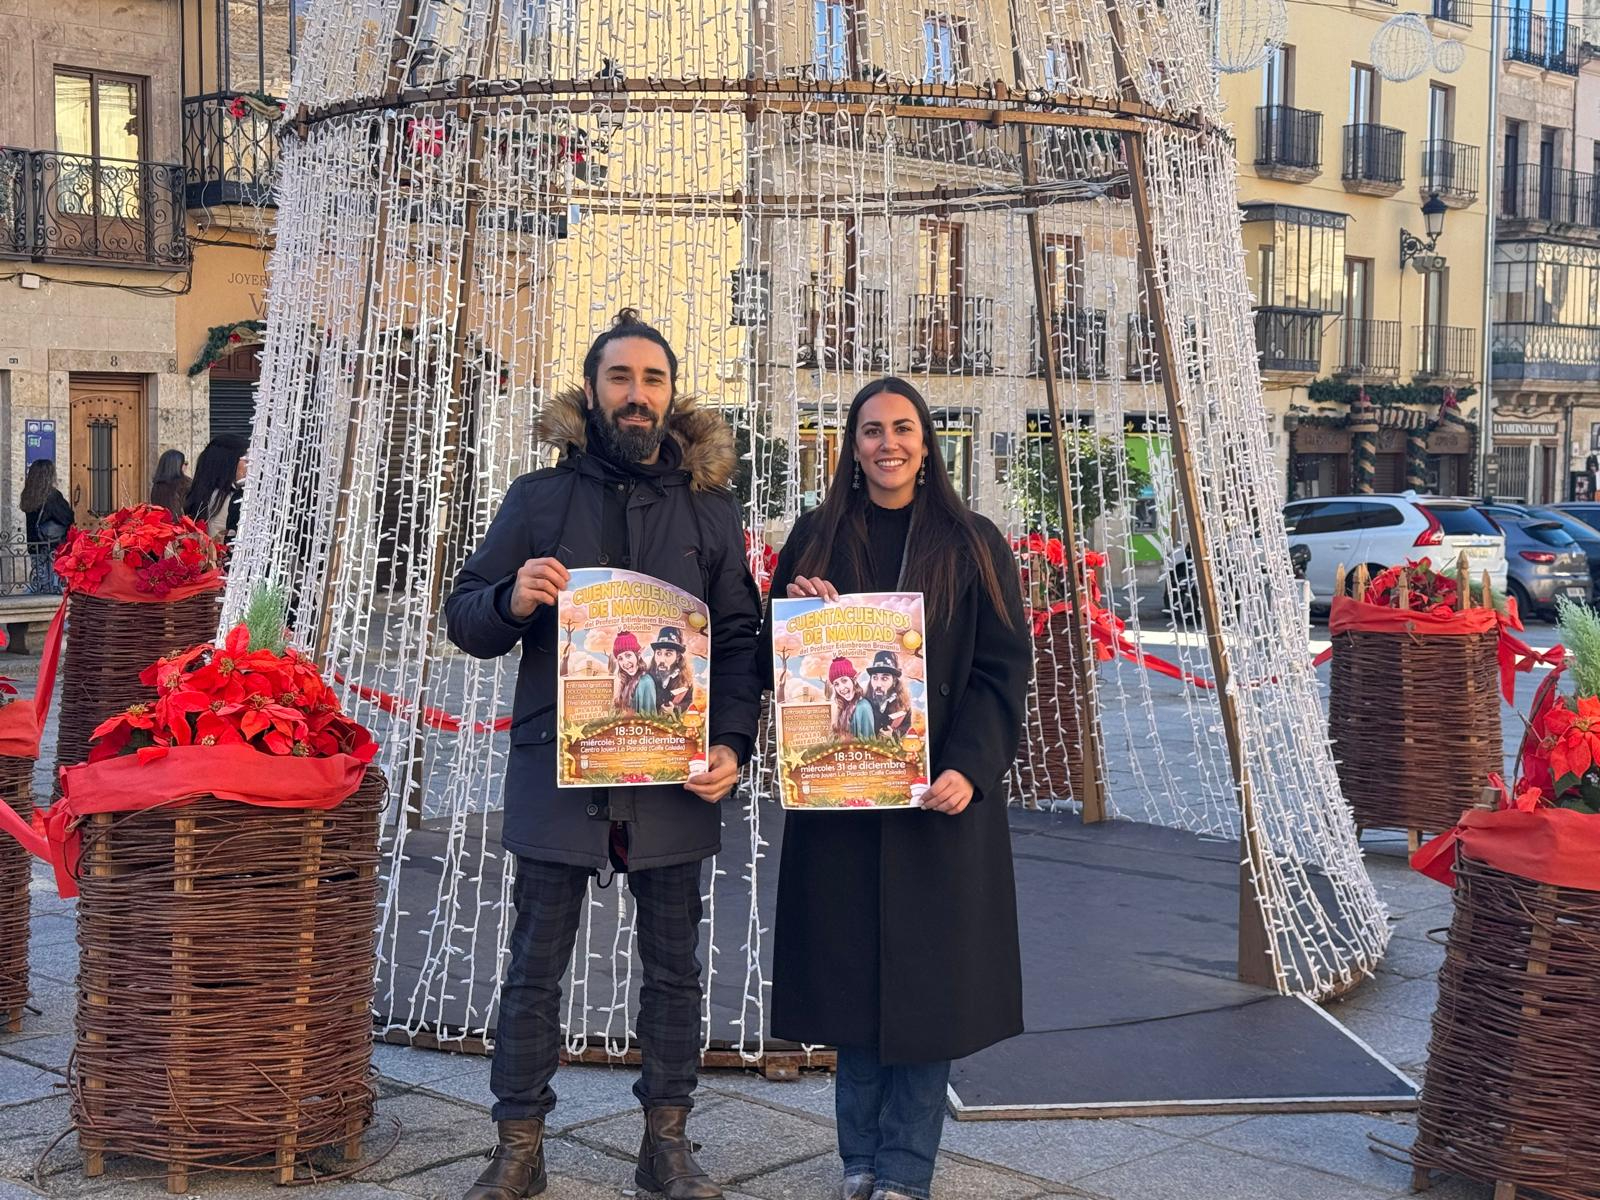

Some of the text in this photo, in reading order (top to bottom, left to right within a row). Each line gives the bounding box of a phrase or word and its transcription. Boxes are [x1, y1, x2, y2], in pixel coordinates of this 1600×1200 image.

[227, 273, 267, 287] JOYER
[110, 355, 118, 367] 8
[573, 580, 696, 611] CUENTACUENTOS
[588, 599, 682, 619] DE NAVIDAD
[787, 606, 911, 632] CUENTACUENTOS
[803, 625, 895, 645] DE NAVIDAD
[615, 727, 654, 736] 18:30 h.
[580, 739, 615, 747] miércoles
[617, 738, 626, 746] 31
[639, 736, 686, 745] diciembre
[834, 751, 874, 761] 18:30 h.
[800, 764, 835, 773] miércoles
[836, 763, 846, 771] 31
[859, 761, 906, 770] diciembre
